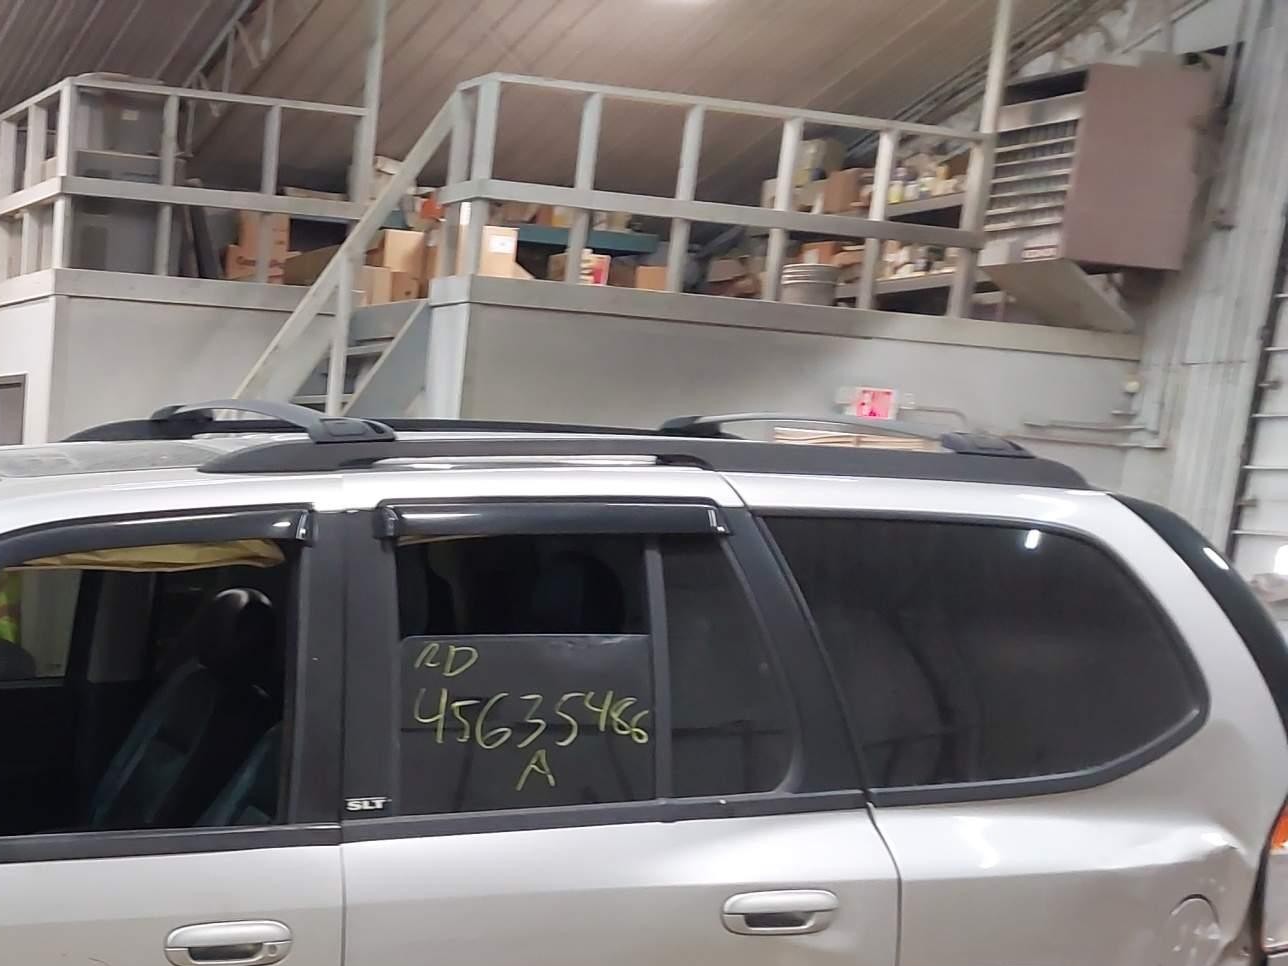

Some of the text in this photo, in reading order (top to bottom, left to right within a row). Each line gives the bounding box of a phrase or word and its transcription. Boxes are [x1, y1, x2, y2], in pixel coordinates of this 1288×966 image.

[414, 687, 650, 749] 45635486
[515, 749, 557, 791] A
[346, 799, 387, 811] SLT
